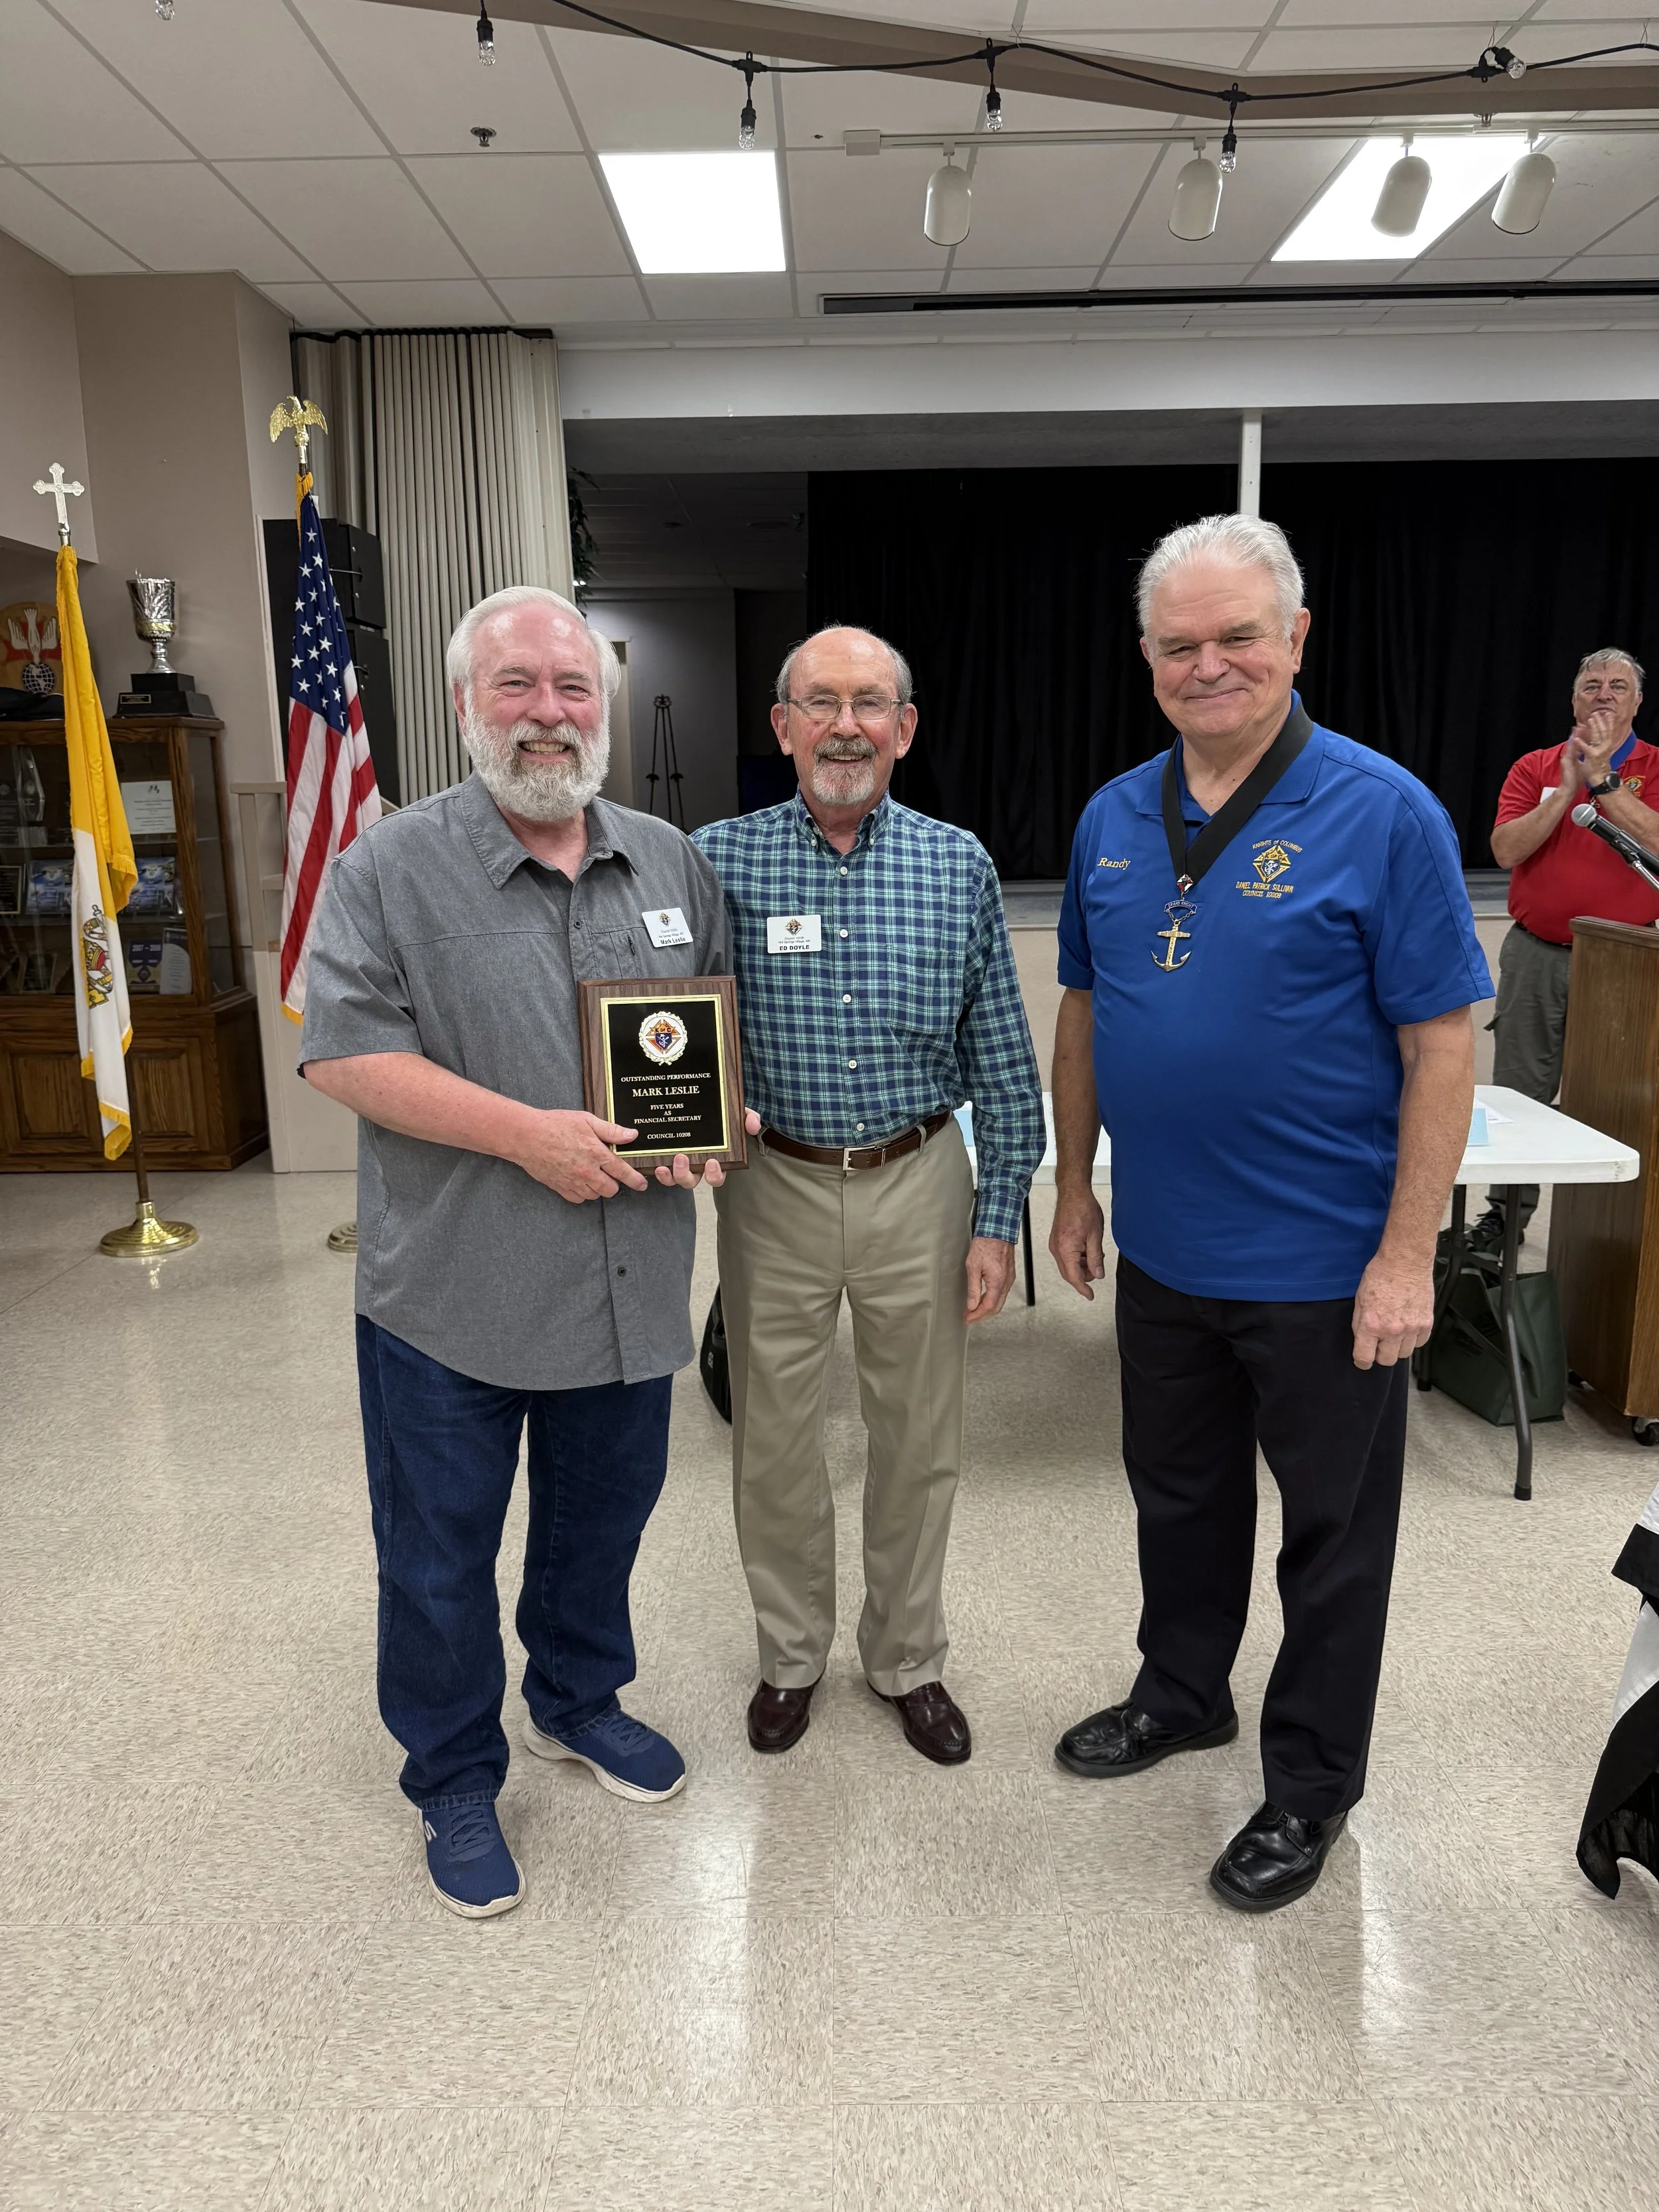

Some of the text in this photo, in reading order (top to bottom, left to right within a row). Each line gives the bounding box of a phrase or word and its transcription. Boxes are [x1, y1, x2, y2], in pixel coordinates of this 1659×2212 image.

[1252, 840, 1271, 849] KNIGHTS
[1280, 840, 1303, 853] COLUMBUS
[1097, 857, 1131, 870] Randy
[632, 1085, 699, 1096] MARK LESLIE
